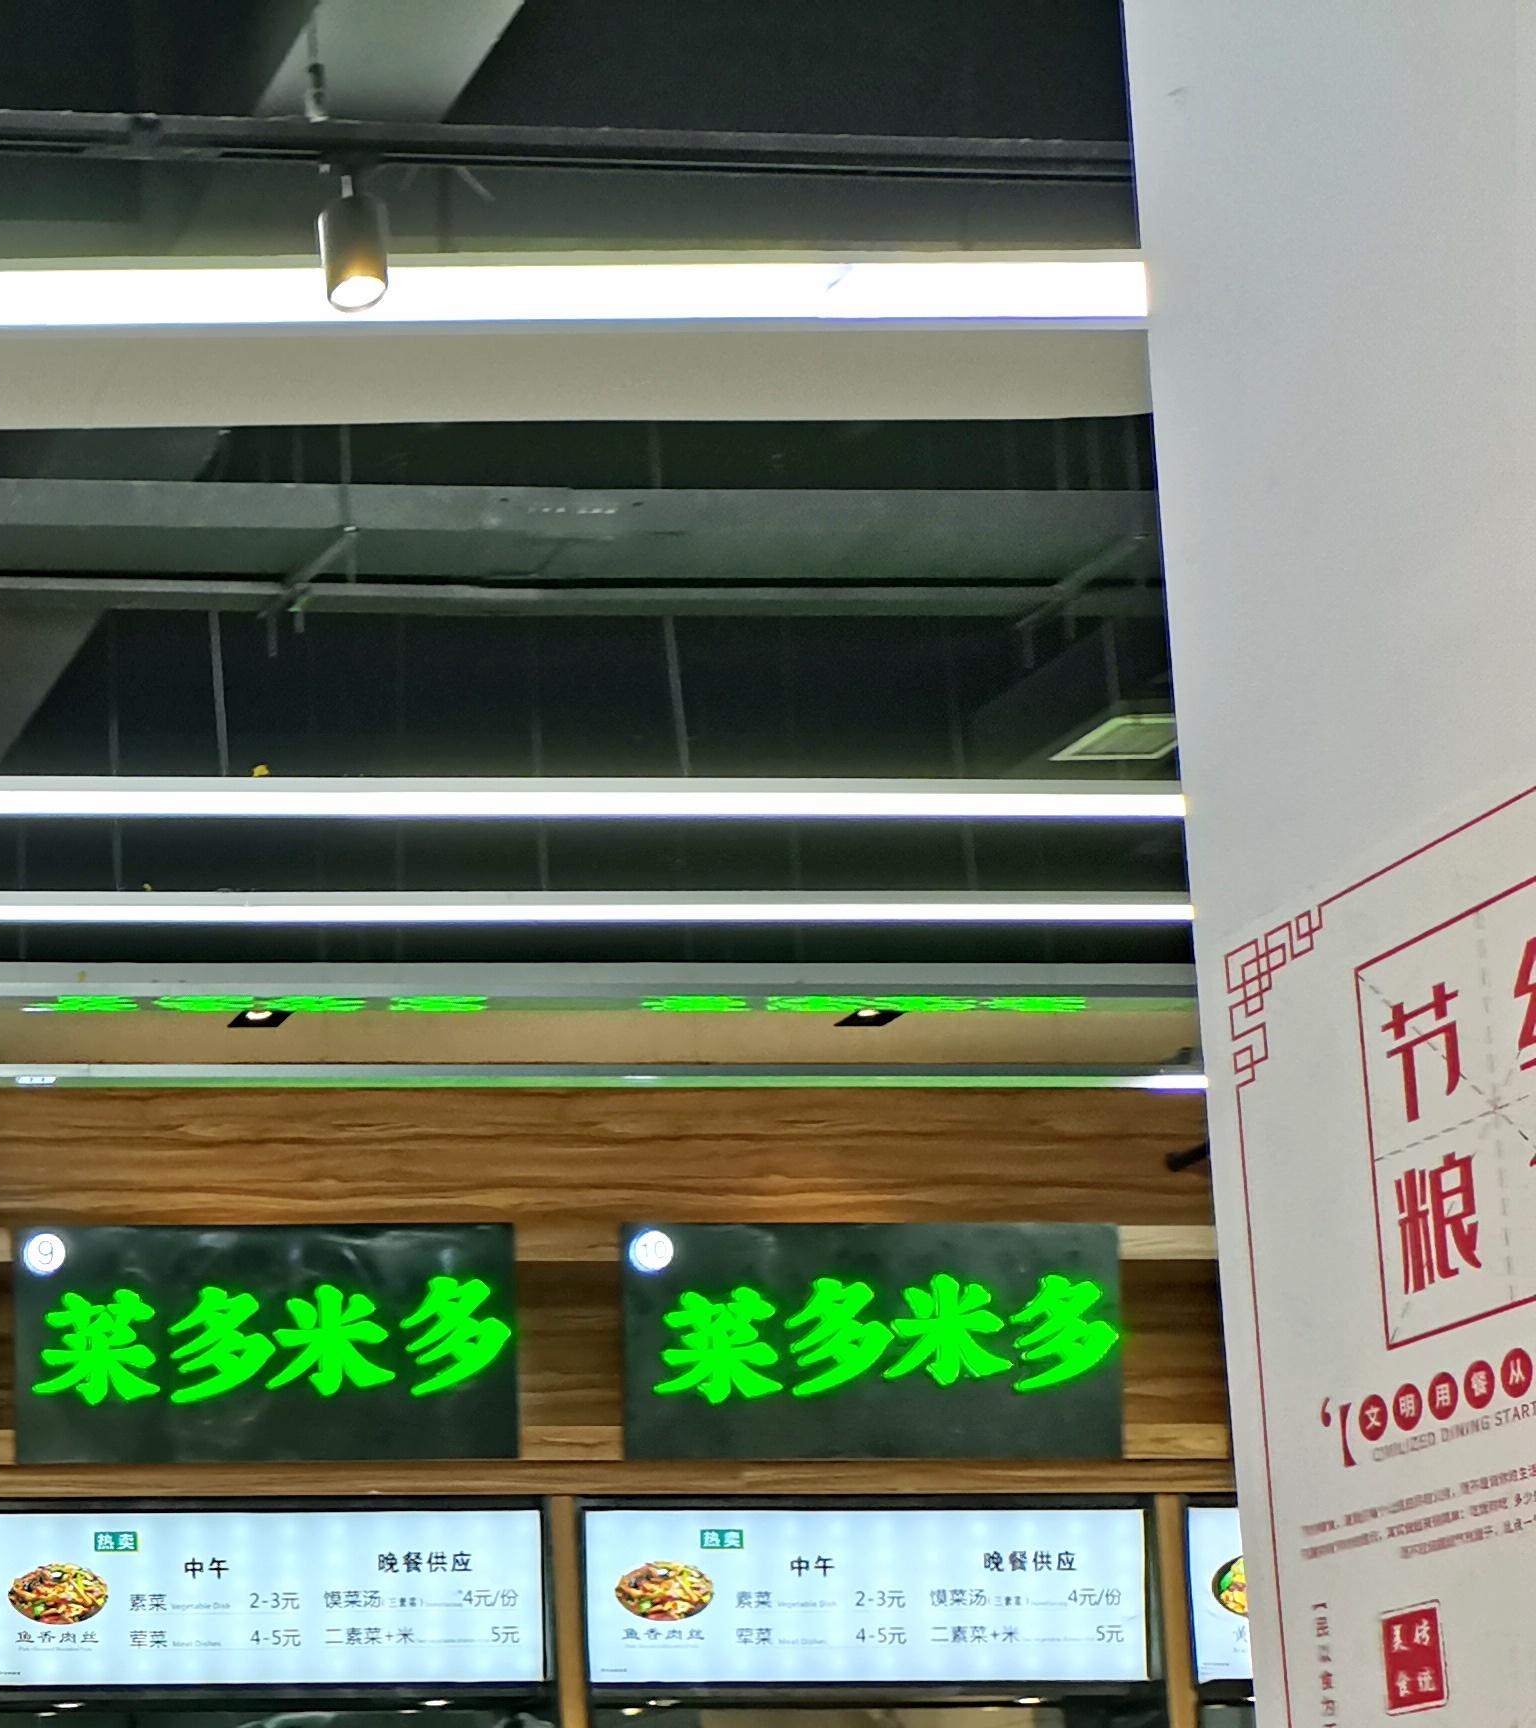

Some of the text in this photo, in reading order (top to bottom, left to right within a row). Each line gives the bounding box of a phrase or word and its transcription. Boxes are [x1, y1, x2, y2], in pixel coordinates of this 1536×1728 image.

[37, 1240, 55, 1265] 9
[639, 1240, 667, 1259] 10
[31, 1275, 513, 1405] 菜多米多
[653, 1273, 1120, 1404] 菜多米多
[1440, 1412, 1490, 1443] DINING
[96, 1533, 136, 1551] 热卖
[702, 1531, 742, 1548] 热卖
[184, 1557, 230, 1580] 中午
[377, 1550, 473, 1574] 晚餐供应
[789, 1555, 836, 1578] 中午
[982, 1549, 1077, 1573] 晚餐供应
[128, 1593, 168, 1613] 素菜
[248, 1592, 301, 1611] 2-3元
[461, 1588, 519, 1608] 4元/份
[734, 1590, 774, 1610] 素菜
[854, 1589, 907, 1609] 2-3元
[1067, 1587, 1123, 1607] 4元/份
[15, 1630, 100, 1645] 鱼香肉丝
[129, 1629, 168, 1649] 荤菜
[249, 1628, 302, 1648] 4-5元
[324, 1625, 521, 1645] 二素菜+米 5元
[854, 1626, 908, 1646] 4-5元
[930, 1624, 1126, 1644] 二素菜+米 5元
